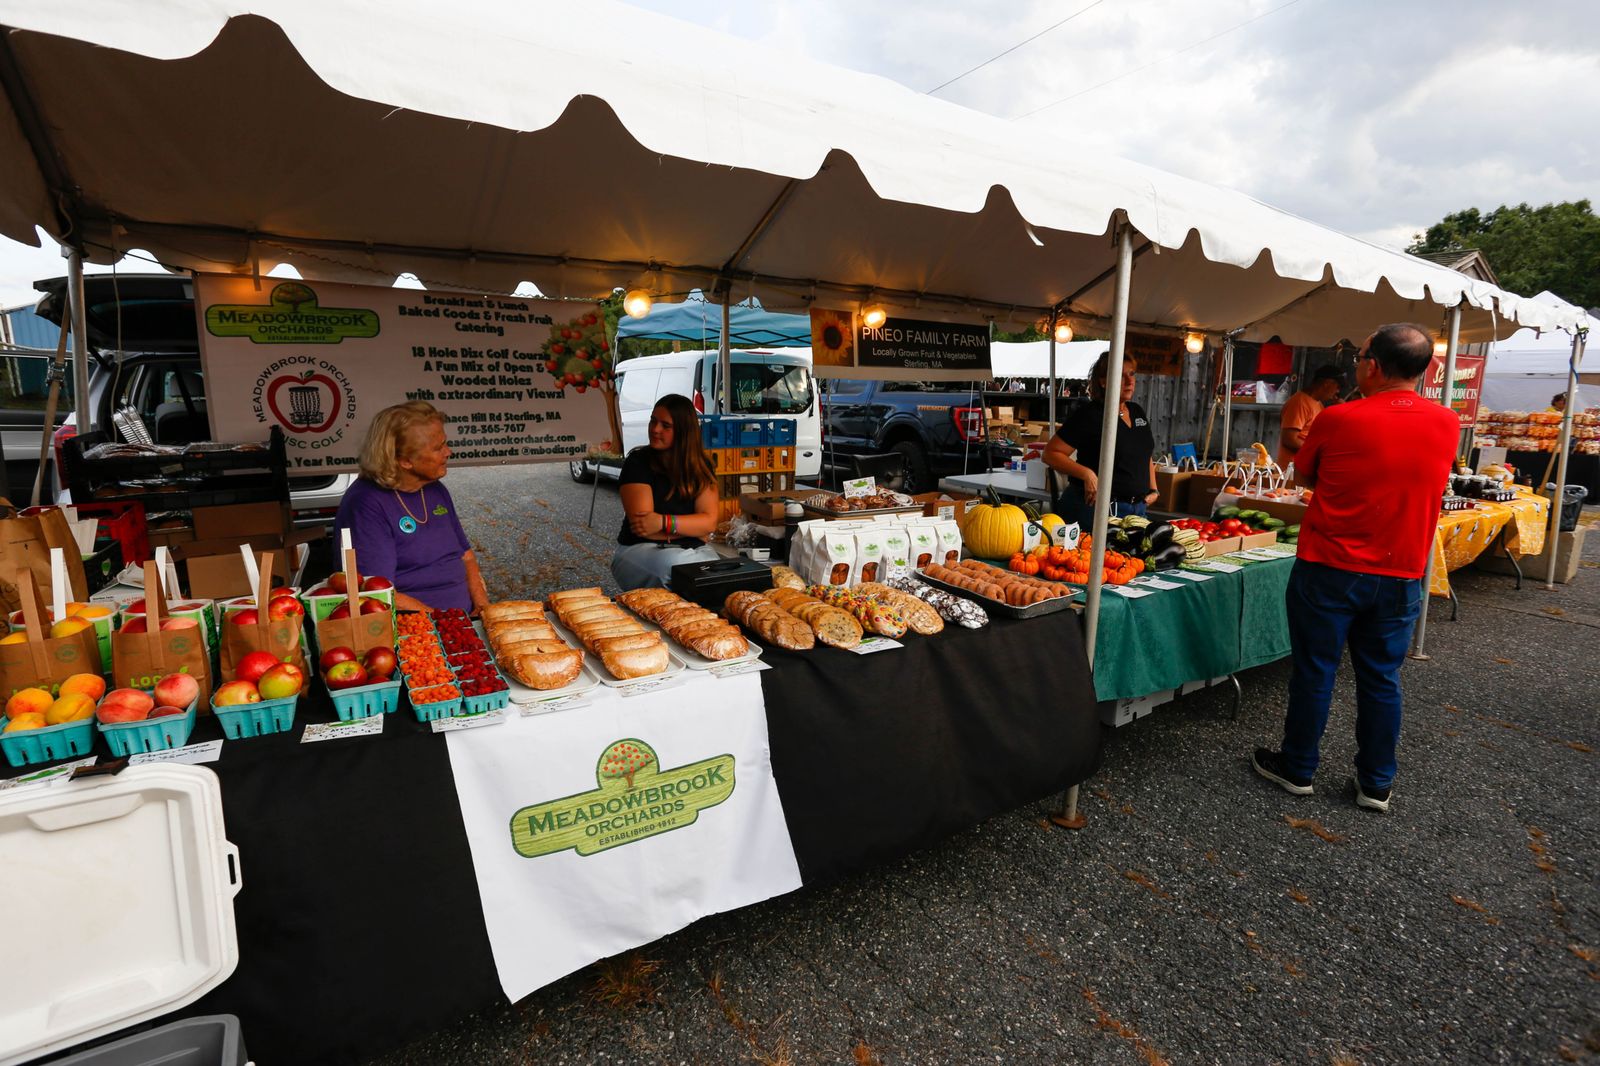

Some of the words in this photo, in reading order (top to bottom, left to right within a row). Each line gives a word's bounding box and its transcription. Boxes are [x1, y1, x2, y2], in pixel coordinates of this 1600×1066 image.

[424, 295, 484, 308] Breakfast
[487, 300, 495, 308] &
[498, 300, 528, 311] Lunch
[218, 310, 367, 327] MEADOWBROOK
[399, 305, 440, 318] Baked
[484, 311, 492, 320] &
[495, 311, 526, 324] Fresh
[528, 314, 552, 326] Fruit
[258, 326, 334, 334] ORCHARDS
[455, 322, 504, 337] Catering
[862, 326, 904, 343] PINEO
[906, 330, 952, 346] FAMILY
[952, 333, 987, 348] FARM
[412, 346, 425, 358] 18
[429, 348, 458, 358] Hole
[487, 348, 509, 359] Golf
[872, 347, 897, 358] Locally
[898, 348, 920, 358] Grown
[920, 350, 936, 358] Fruit
[936, 350, 942, 358] &
[943, 351, 977, 362] Vegetables
[424, 361, 432, 371] A
[436, 361, 458, 372] Fun
[462, 361, 484, 372] Mix
[487, 362, 500, 372] of
[504, 362, 533, 374] Open
[536, 363, 544, 372] &
[441, 374, 495, 386] Wooded
[252, 356, 317, 422] MEADOWBROOK
[319, 360, 356, 420] ORCHARDS
[406, 388, 434, 400] with
[438, 388, 523, 402] extraordinary
[1425, 387, 1442, 398] MAPL
[1452, 388, 1477, 400] RODUCTS
[472, 412, 487, 422] Hill
[490, 412, 502, 422] Rd
[504, 411, 544, 424] Sterling,
[546, 412, 562, 420] MA
[458, 424, 526, 434] 978-365-7617
[284, 436, 307, 449] ISC
[311, 428, 344, 449] GOLF
[446, 434, 576, 448] eadowbrookorchards.com
[294, 457, 322, 468] Year
[130, 675, 162, 688] LOC
[528, 764, 726, 837] MEADOWBROOK
[585, 800, 686, 837] ORCHARDS
[599, 824, 654, 846] ESTABLISHED
[656, 818, 676, 830] 1912
